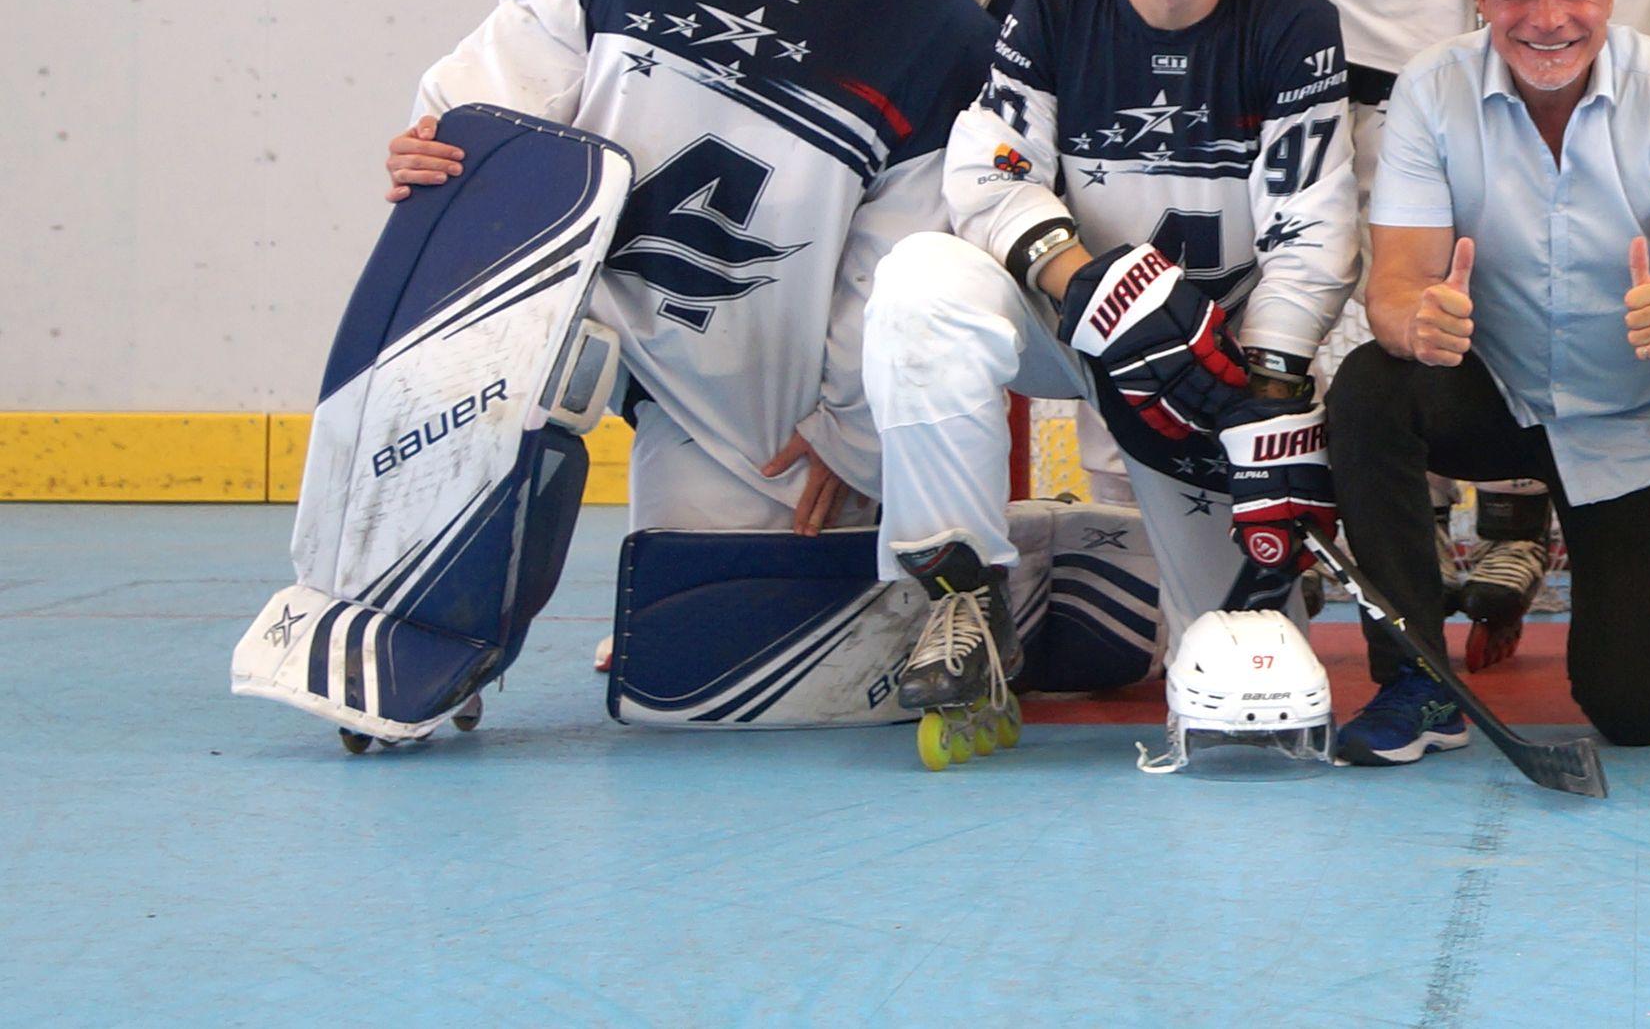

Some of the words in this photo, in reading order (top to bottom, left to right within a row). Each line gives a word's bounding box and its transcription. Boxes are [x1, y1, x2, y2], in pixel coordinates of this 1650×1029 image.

[1152, 54, 1188, 69] CIT
[1264, 115, 1342, 197] 97
[373, 378, 509, 478] BAUER
[1252, 655, 1274, 669] 97
